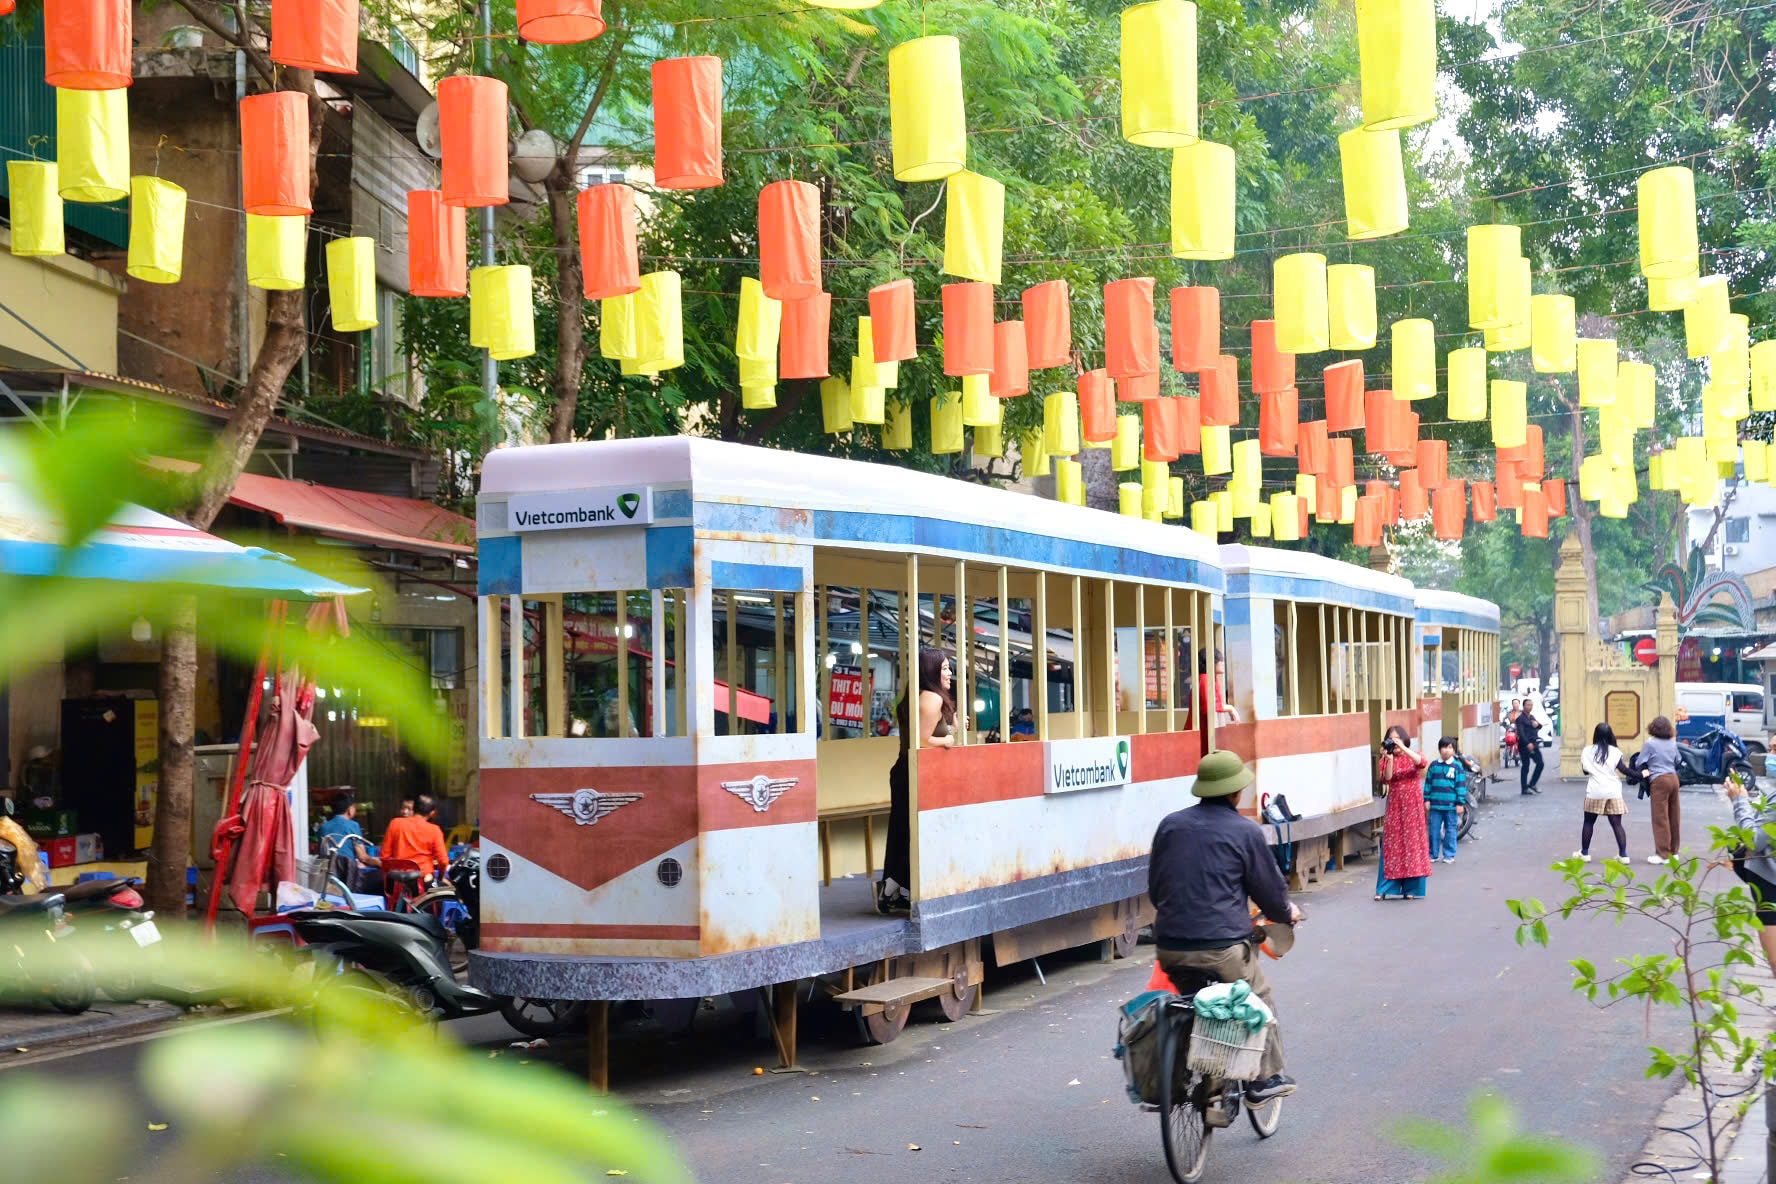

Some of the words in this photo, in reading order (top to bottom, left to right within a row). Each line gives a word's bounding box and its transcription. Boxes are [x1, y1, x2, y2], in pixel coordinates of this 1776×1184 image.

[515, 505, 615, 526] Vietcombank
[834, 666, 849, 674] 31
[1054, 759, 1115, 788] Vietcombank
